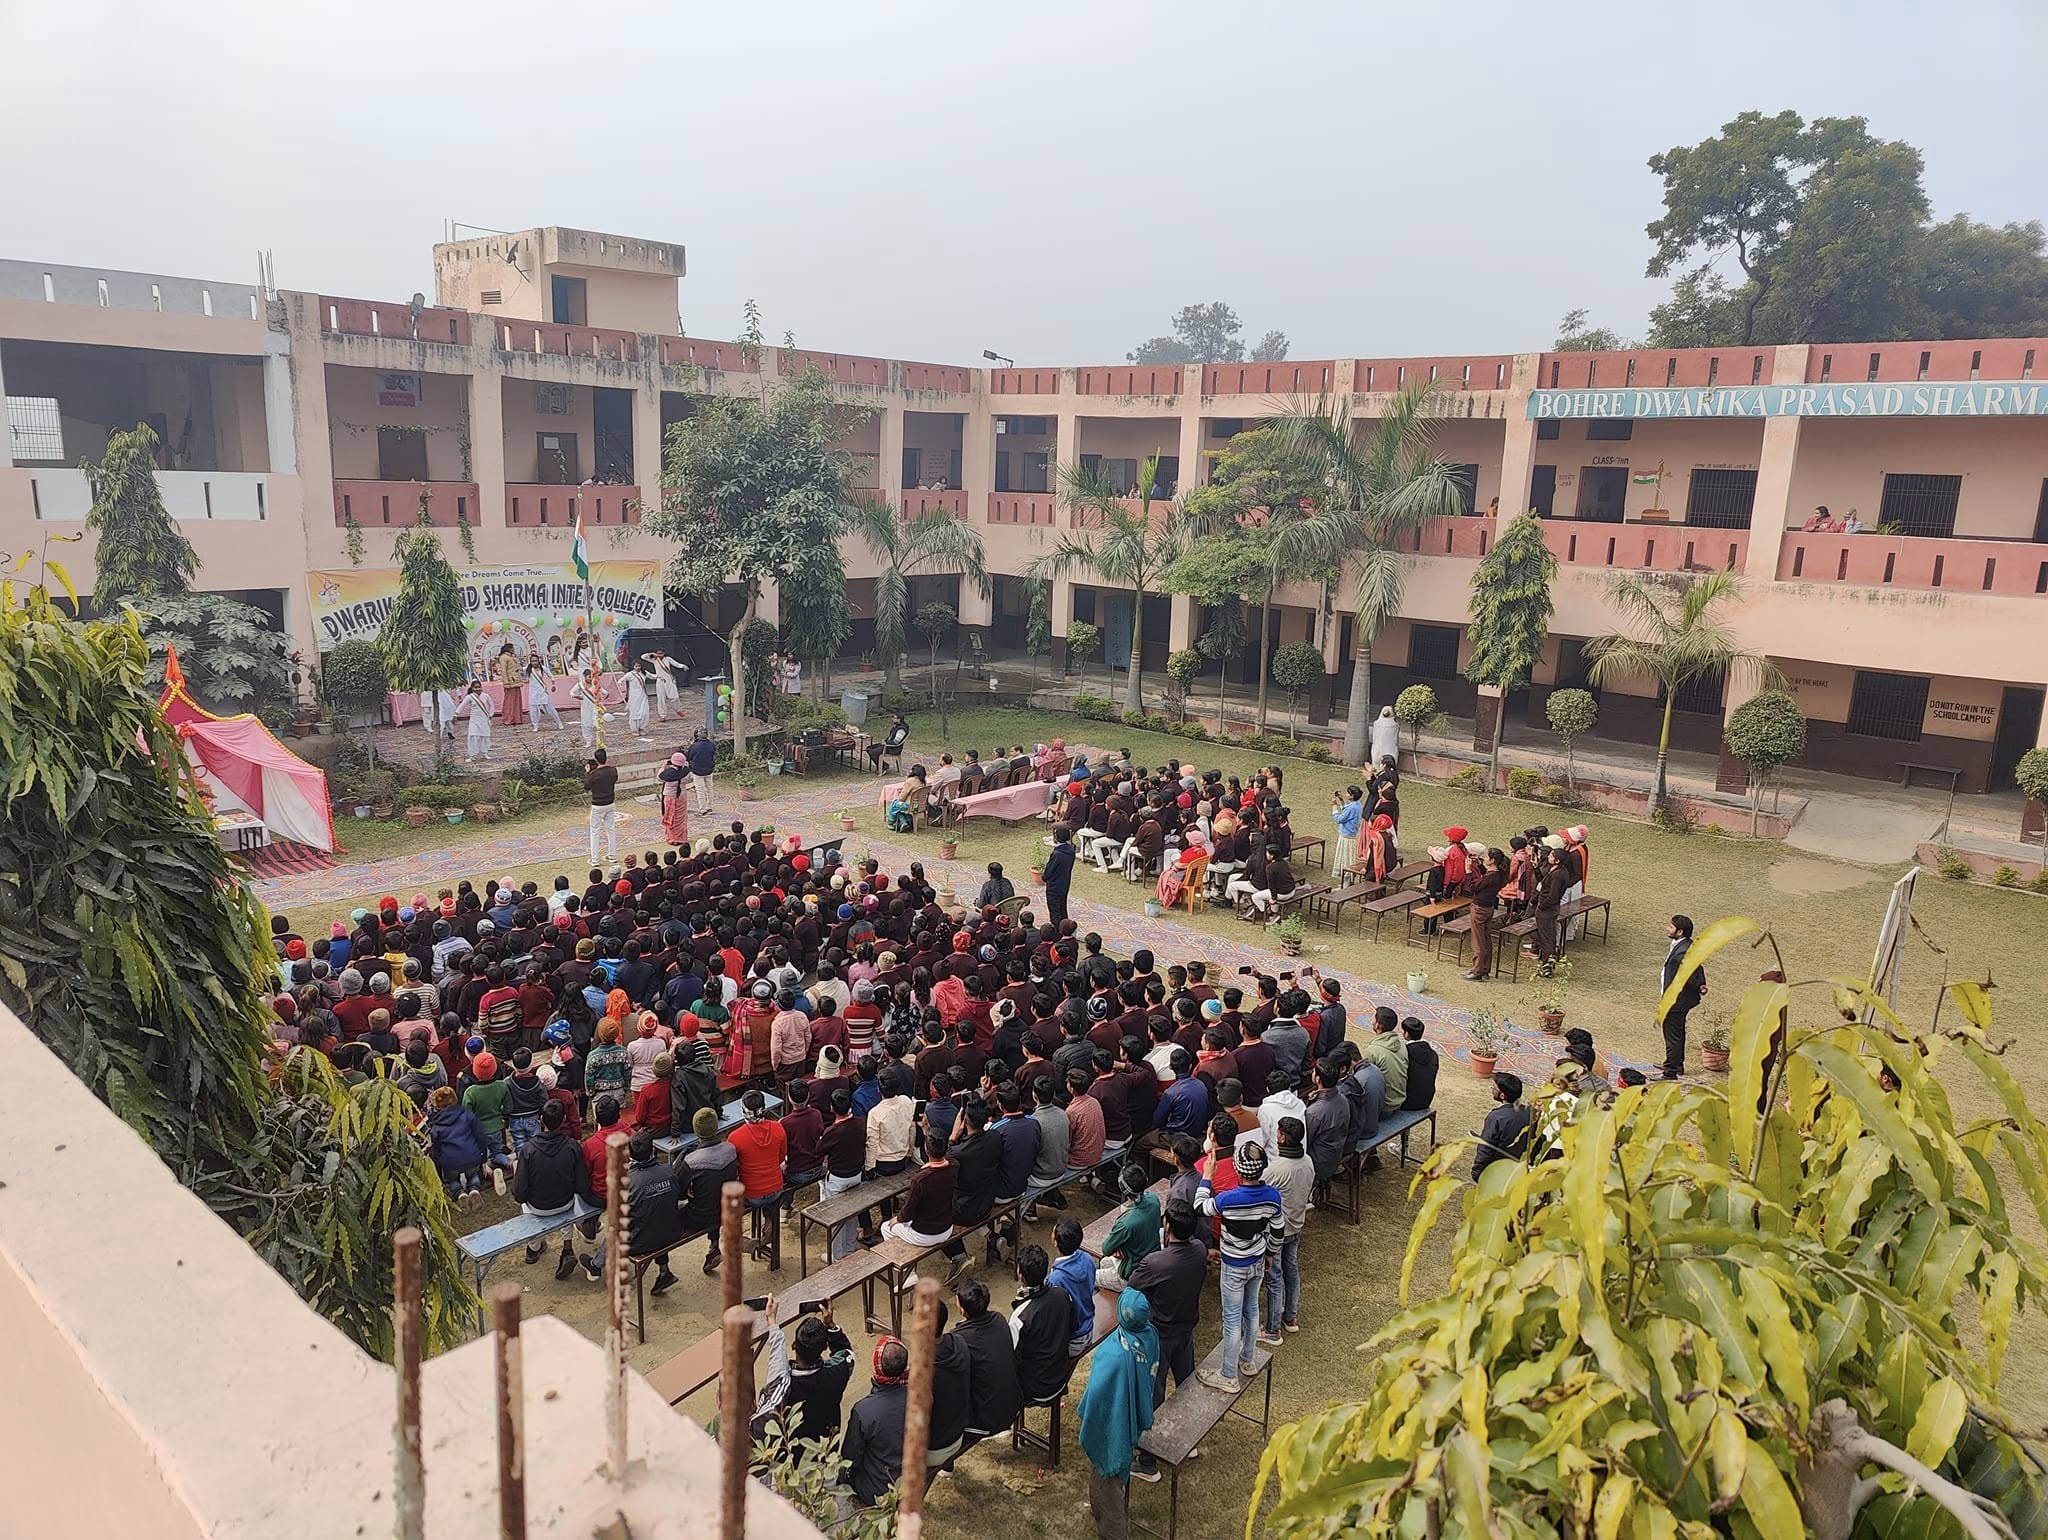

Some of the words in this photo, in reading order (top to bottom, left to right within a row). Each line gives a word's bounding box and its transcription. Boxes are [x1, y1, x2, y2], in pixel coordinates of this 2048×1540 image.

[1536, 391, 1627, 418] BOHRE
[1632, 388, 1769, 417] DWARIKA
[1776, 387, 1904, 416] PRASAD
[472, 570, 501, 578] Dreams
[503, 569, 524, 577] Come
[320, 596, 393, 640] DWARIK
[482, 583, 548, 611] SHARMA
[596, 586, 656, 622] COLLEGE
[1929, 700, 1940, 709] DO
[1940, 702, 1954, 711] NOT
[1954, 703, 1970, 713] RUN
[1970, 705, 1978, 714] IN
[1979, 706, 1997, 716] THE
[1933, 709, 1960, 721] SCHOOL
[1960, 713, 1992, 725] CAMPUS
